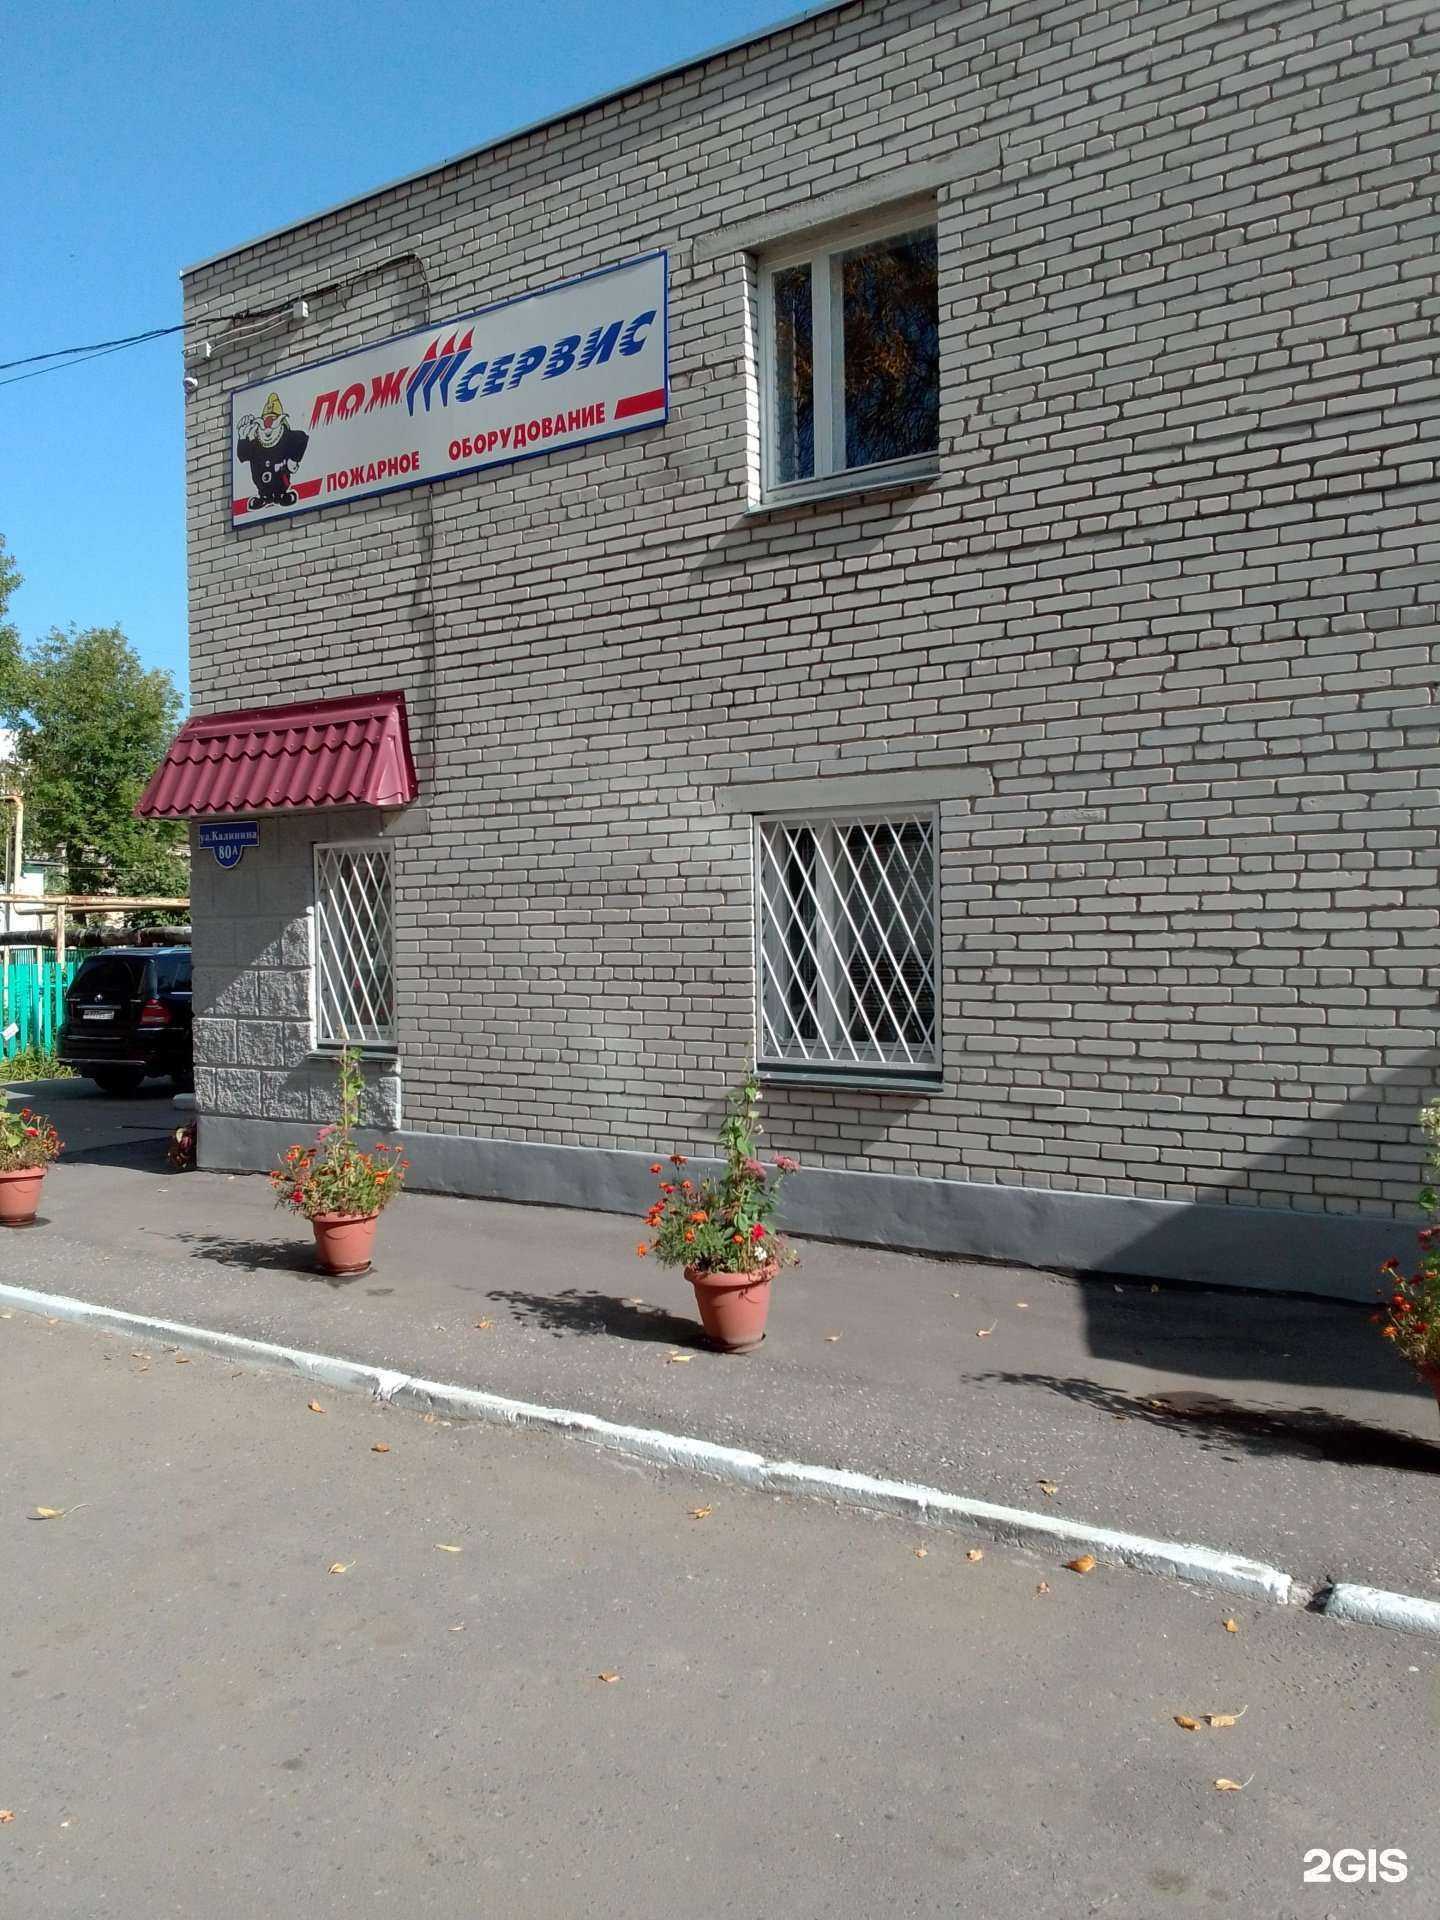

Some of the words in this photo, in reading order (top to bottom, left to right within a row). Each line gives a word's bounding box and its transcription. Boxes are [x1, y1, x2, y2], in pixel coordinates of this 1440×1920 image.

[455, 310, 657, 403] СЕРВИС
[327, 450, 420, 493] ПОЖАРНОЕ
[449, 402, 606, 461] ОБОРУДОВАНИЕ
